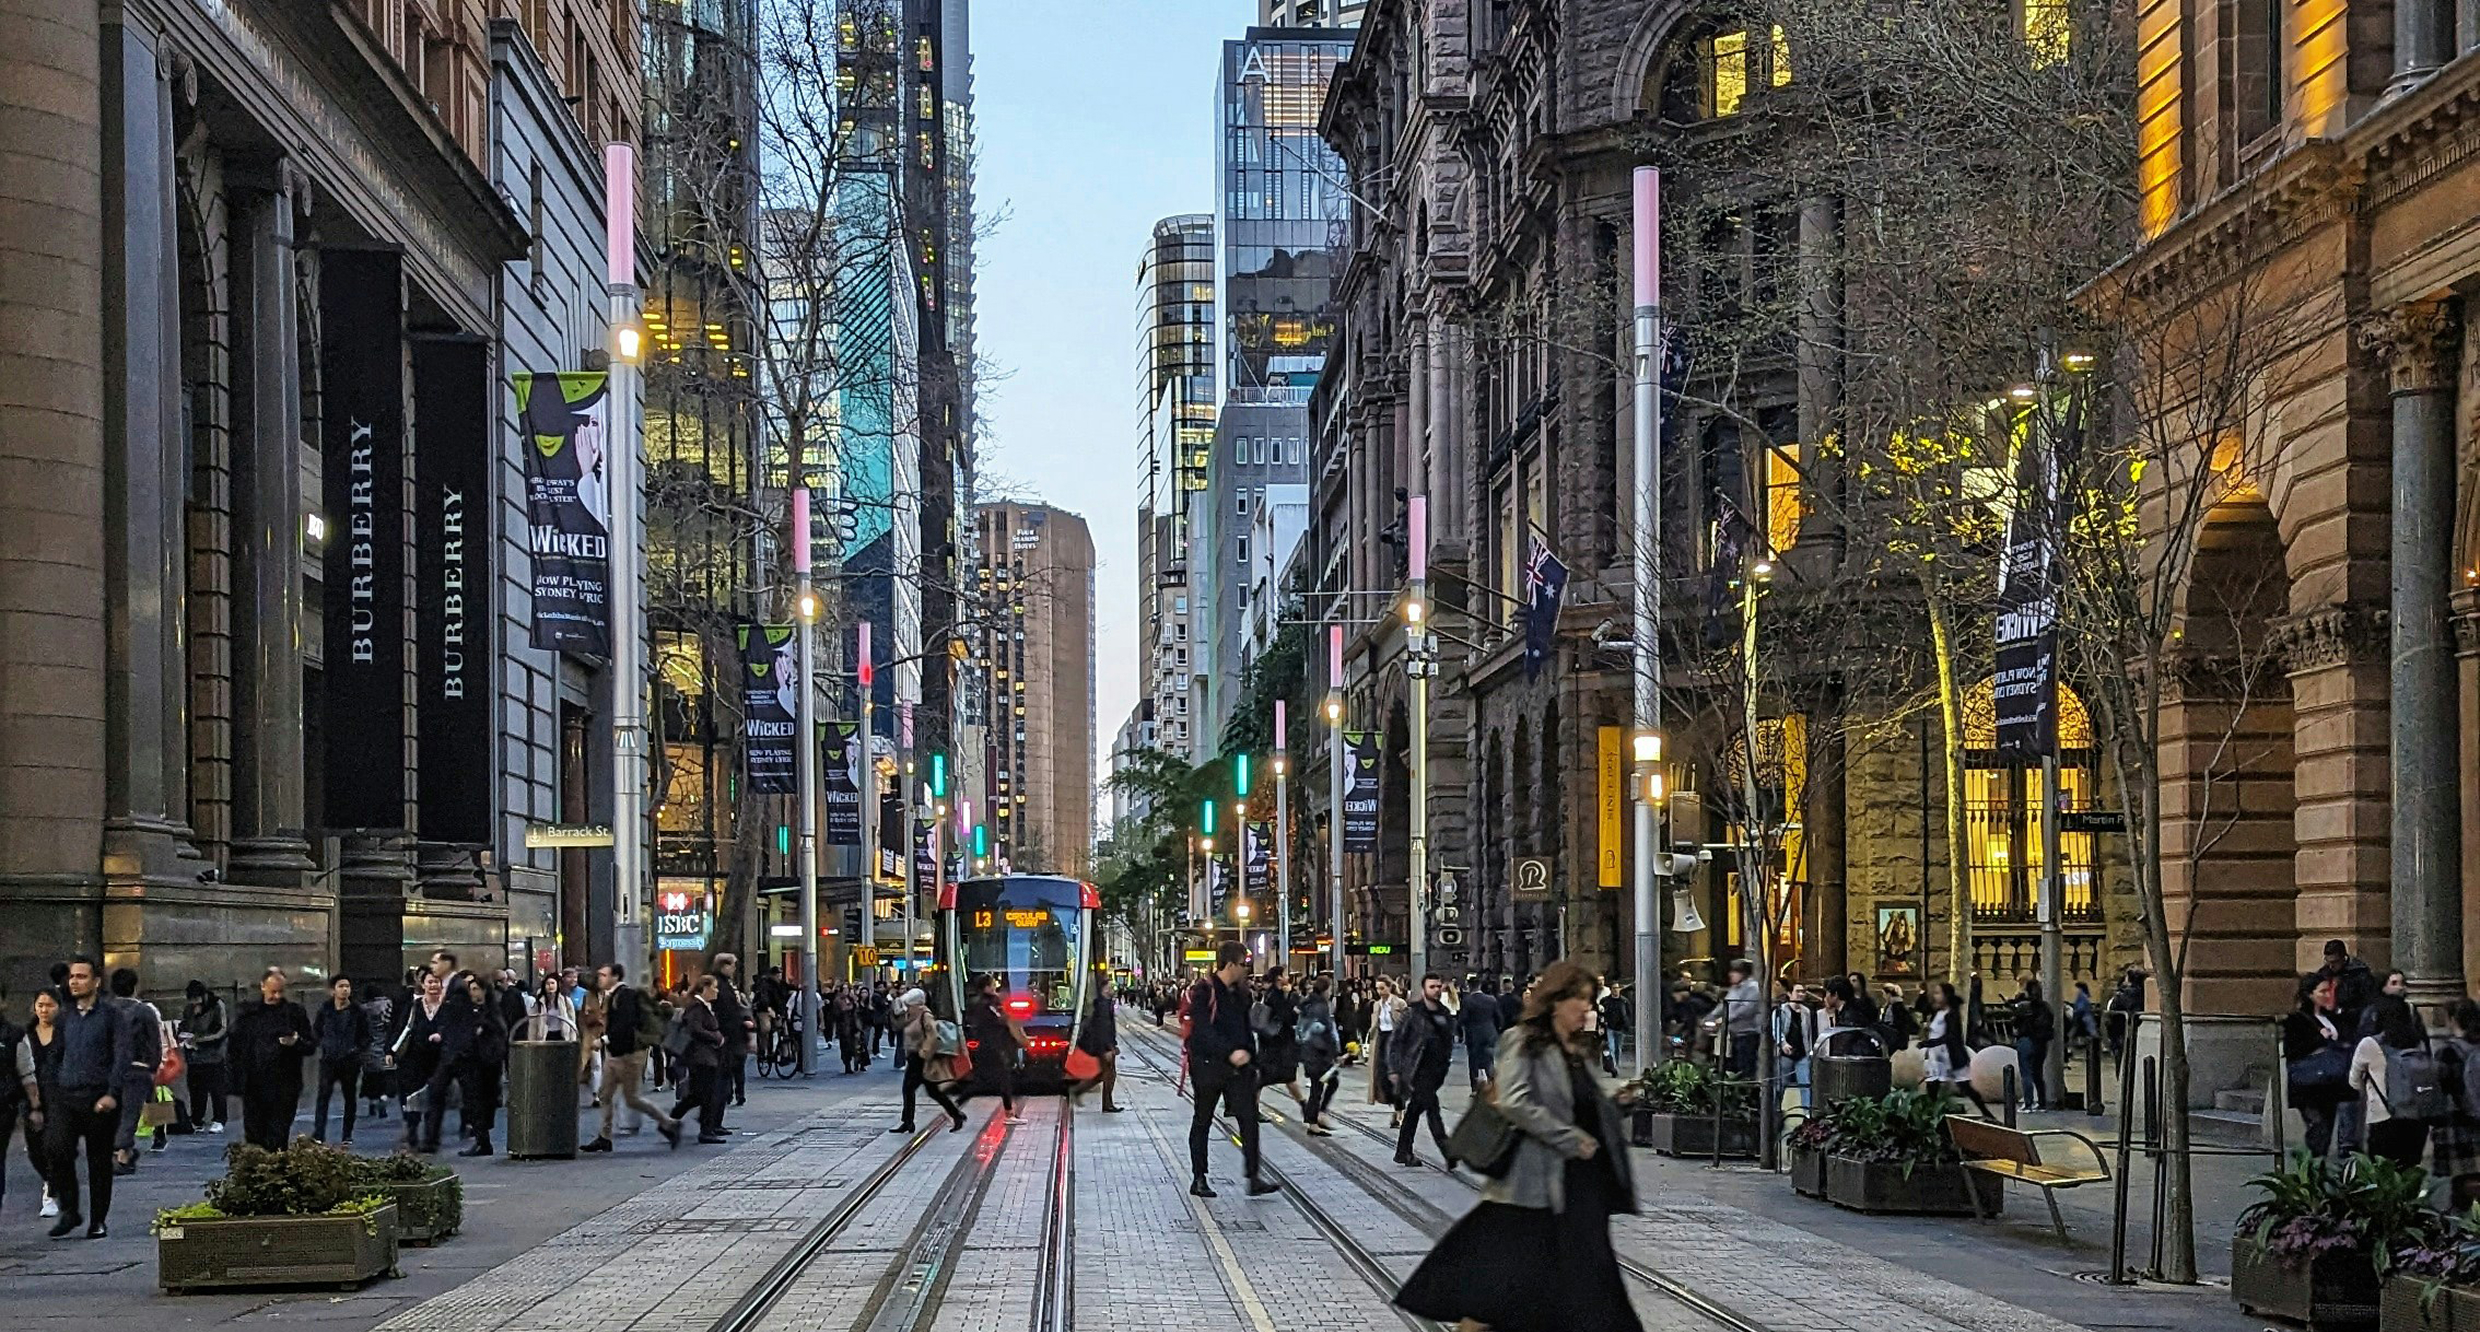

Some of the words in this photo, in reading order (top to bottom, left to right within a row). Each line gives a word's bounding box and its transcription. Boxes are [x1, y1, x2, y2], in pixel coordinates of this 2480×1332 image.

[351, 416, 373, 664] BURBERRY
[443, 484, 464, 700] BURBERRY
[534, 587, 577, 599] SYDNEY
[2082, 815, 2115, 825] Martin
[547, 826, 593, 838] Barrack
[595, 825, 609, 837] St
[975, 911, 992, 928] L3
[1005, 911, 1048, 921] CIRCULAR
[861, 950, 876, 963] 10
